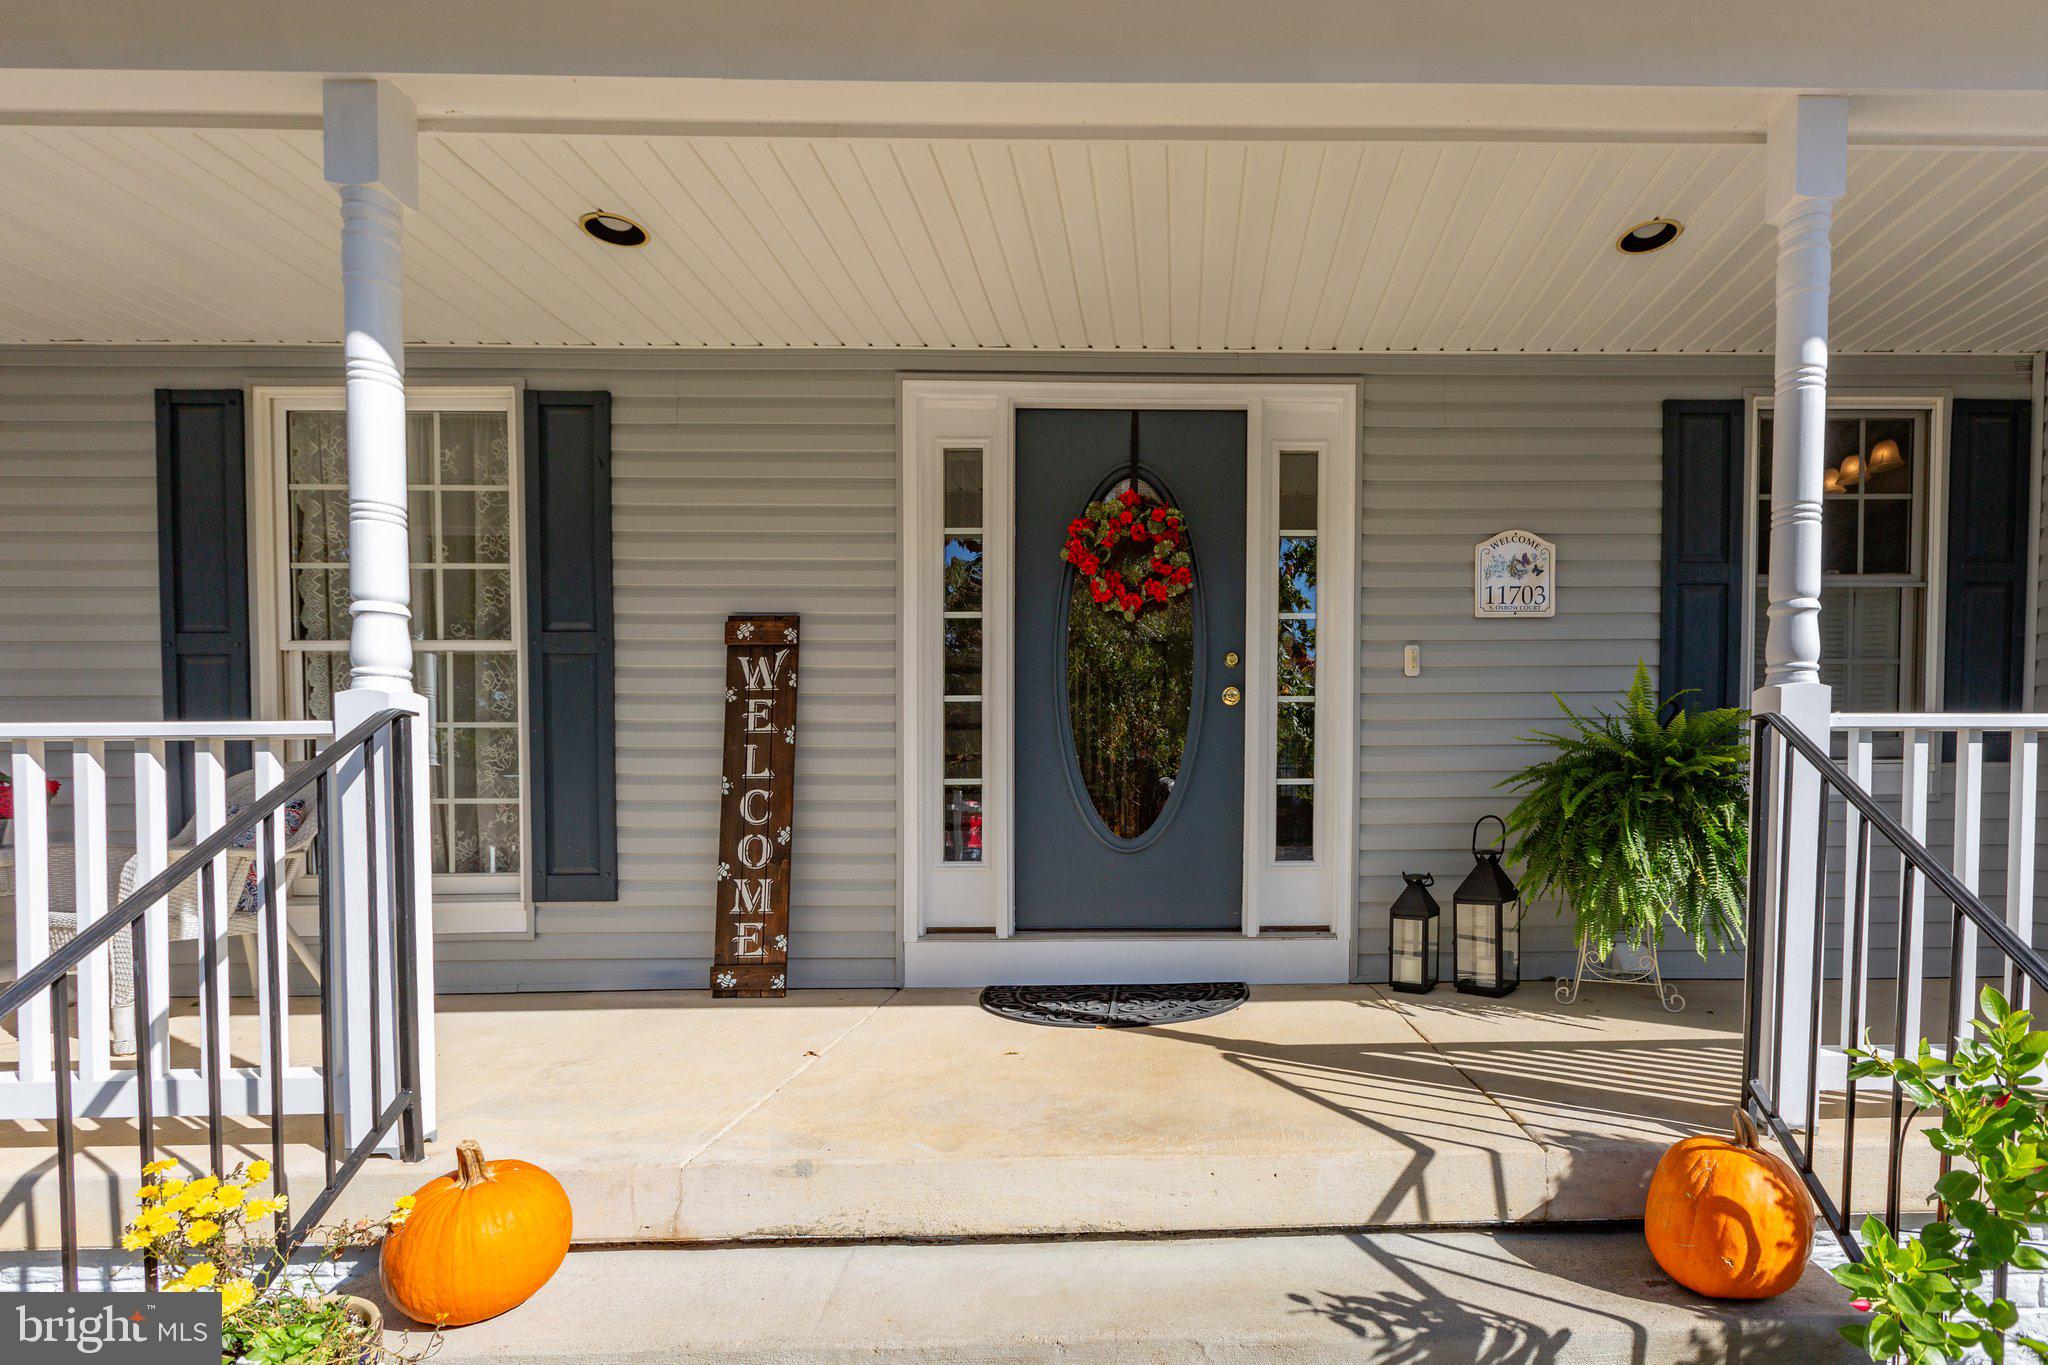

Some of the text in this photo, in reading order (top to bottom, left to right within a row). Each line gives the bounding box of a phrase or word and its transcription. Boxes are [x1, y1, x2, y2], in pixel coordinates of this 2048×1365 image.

[1490, 536, 1541, 550] WELCOME
[1485, 585, 1546, 605] 11703
[729, 648, 790, 959] WELCOME
